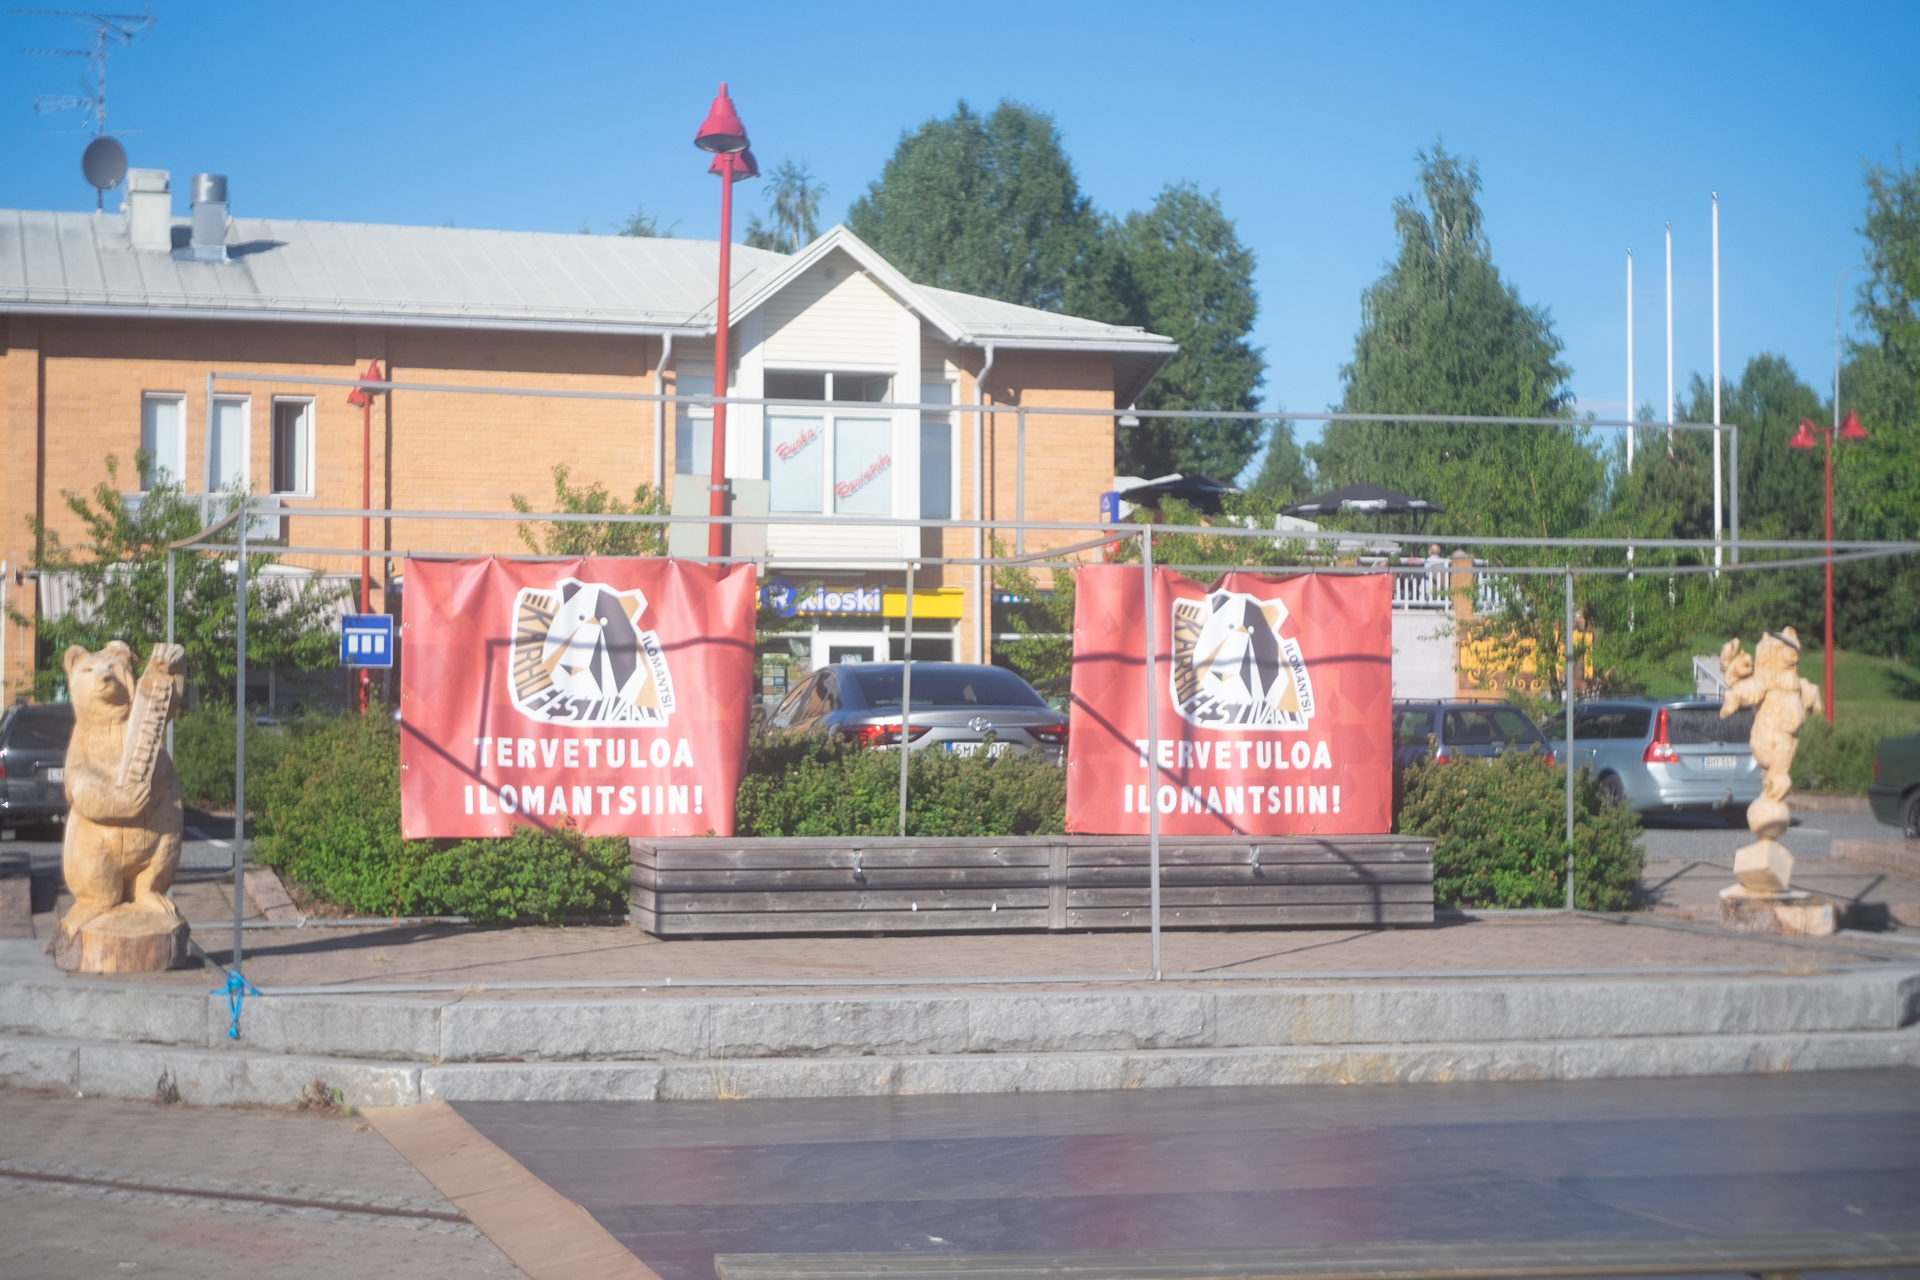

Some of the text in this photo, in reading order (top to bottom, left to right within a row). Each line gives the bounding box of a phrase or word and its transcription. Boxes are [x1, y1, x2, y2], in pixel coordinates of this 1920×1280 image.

[800, 585, 881, 612] kioski
[642, 635, 673, 709] ILOMANTSI
[1283, 643, 1312, 713] ILOMANTSI
[525, 688, 664, 721] FESTIVAALI
[1183, 694, 1304, 725] FESTIVAALI
[474, 737, 694, 769] TERVETULOA
[1135, 739, 1332, 770] TERVETULOA
[464, 785, 704, 816] ILOMANTSIIN!
[1124, 784, 1341, 815] ILOMANTSIIN!
